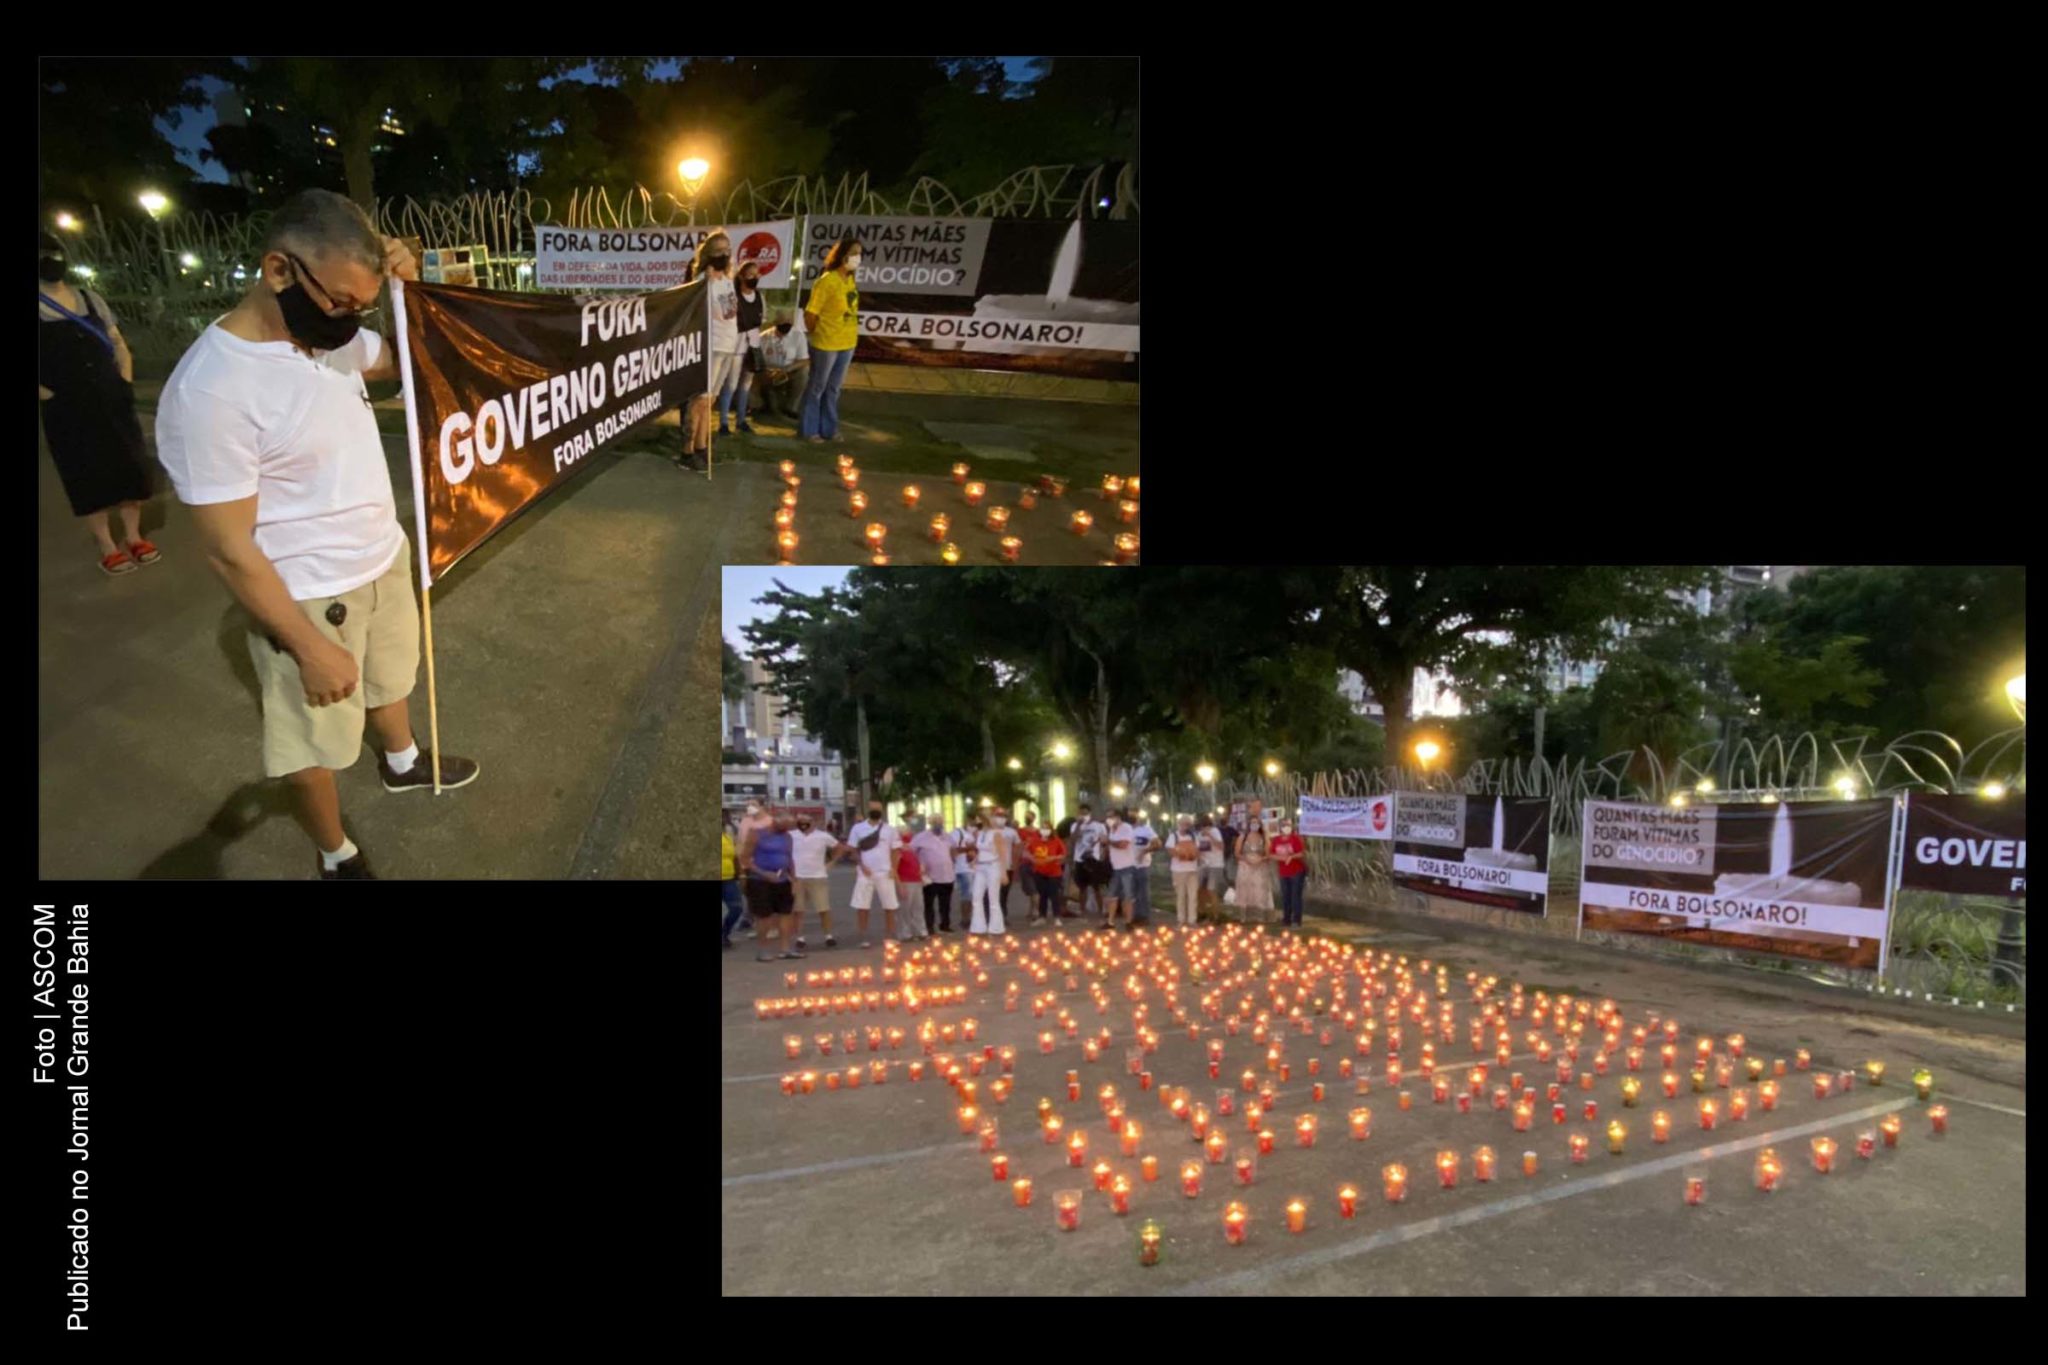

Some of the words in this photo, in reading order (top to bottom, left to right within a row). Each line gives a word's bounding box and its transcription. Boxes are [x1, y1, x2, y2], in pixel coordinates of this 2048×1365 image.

[543, 232, 592, 252] FORA
[599, 231, 709, 252] BOLSONAR
[812, 223, 906, 242] QUANTAS
[911, 221, 967, 243] MÃES
[740, 246, 778, 260] FRA
[809, 244, 877, 263] FOM
[883, 242, 963, 264] VÍTIMAS
[553, 261, 566, 271] EM
[568, 261, 604, 272] DEFEA
[806, 264, 826, 280] D
[855, 264, 967, 286] ENOCÍDIO?
[540, 274, 558, 283] DAS
[560, 274, 617, 284] LIBERDADES
[619, 274, 626, 284] E
[628, 274, 642, 284] DO
[581, 297, 647, 347] FORA
[920, 318, 1084, 345] BOLSONARO!
[439, 361, 606, 485] GOVERNO
[612, 331, 702, 398] GENOCIDA!
[553, 429, 594, 473] FORA
[596, 390, 662, 446] BOLSONARO!
[1593, 807, 1657, 824] QUANTAS
[1593, 825, 1639, 842] FORAM
[1592, 844, 1613, 858] DO
[1417, 859, 1440, 874] FORA
[1443, 863, 1511, 885] BOLSONARO!
[1629, 890, 1671, 911] FORA
[1677, 896, 1806, 926] BOLSONARO!
